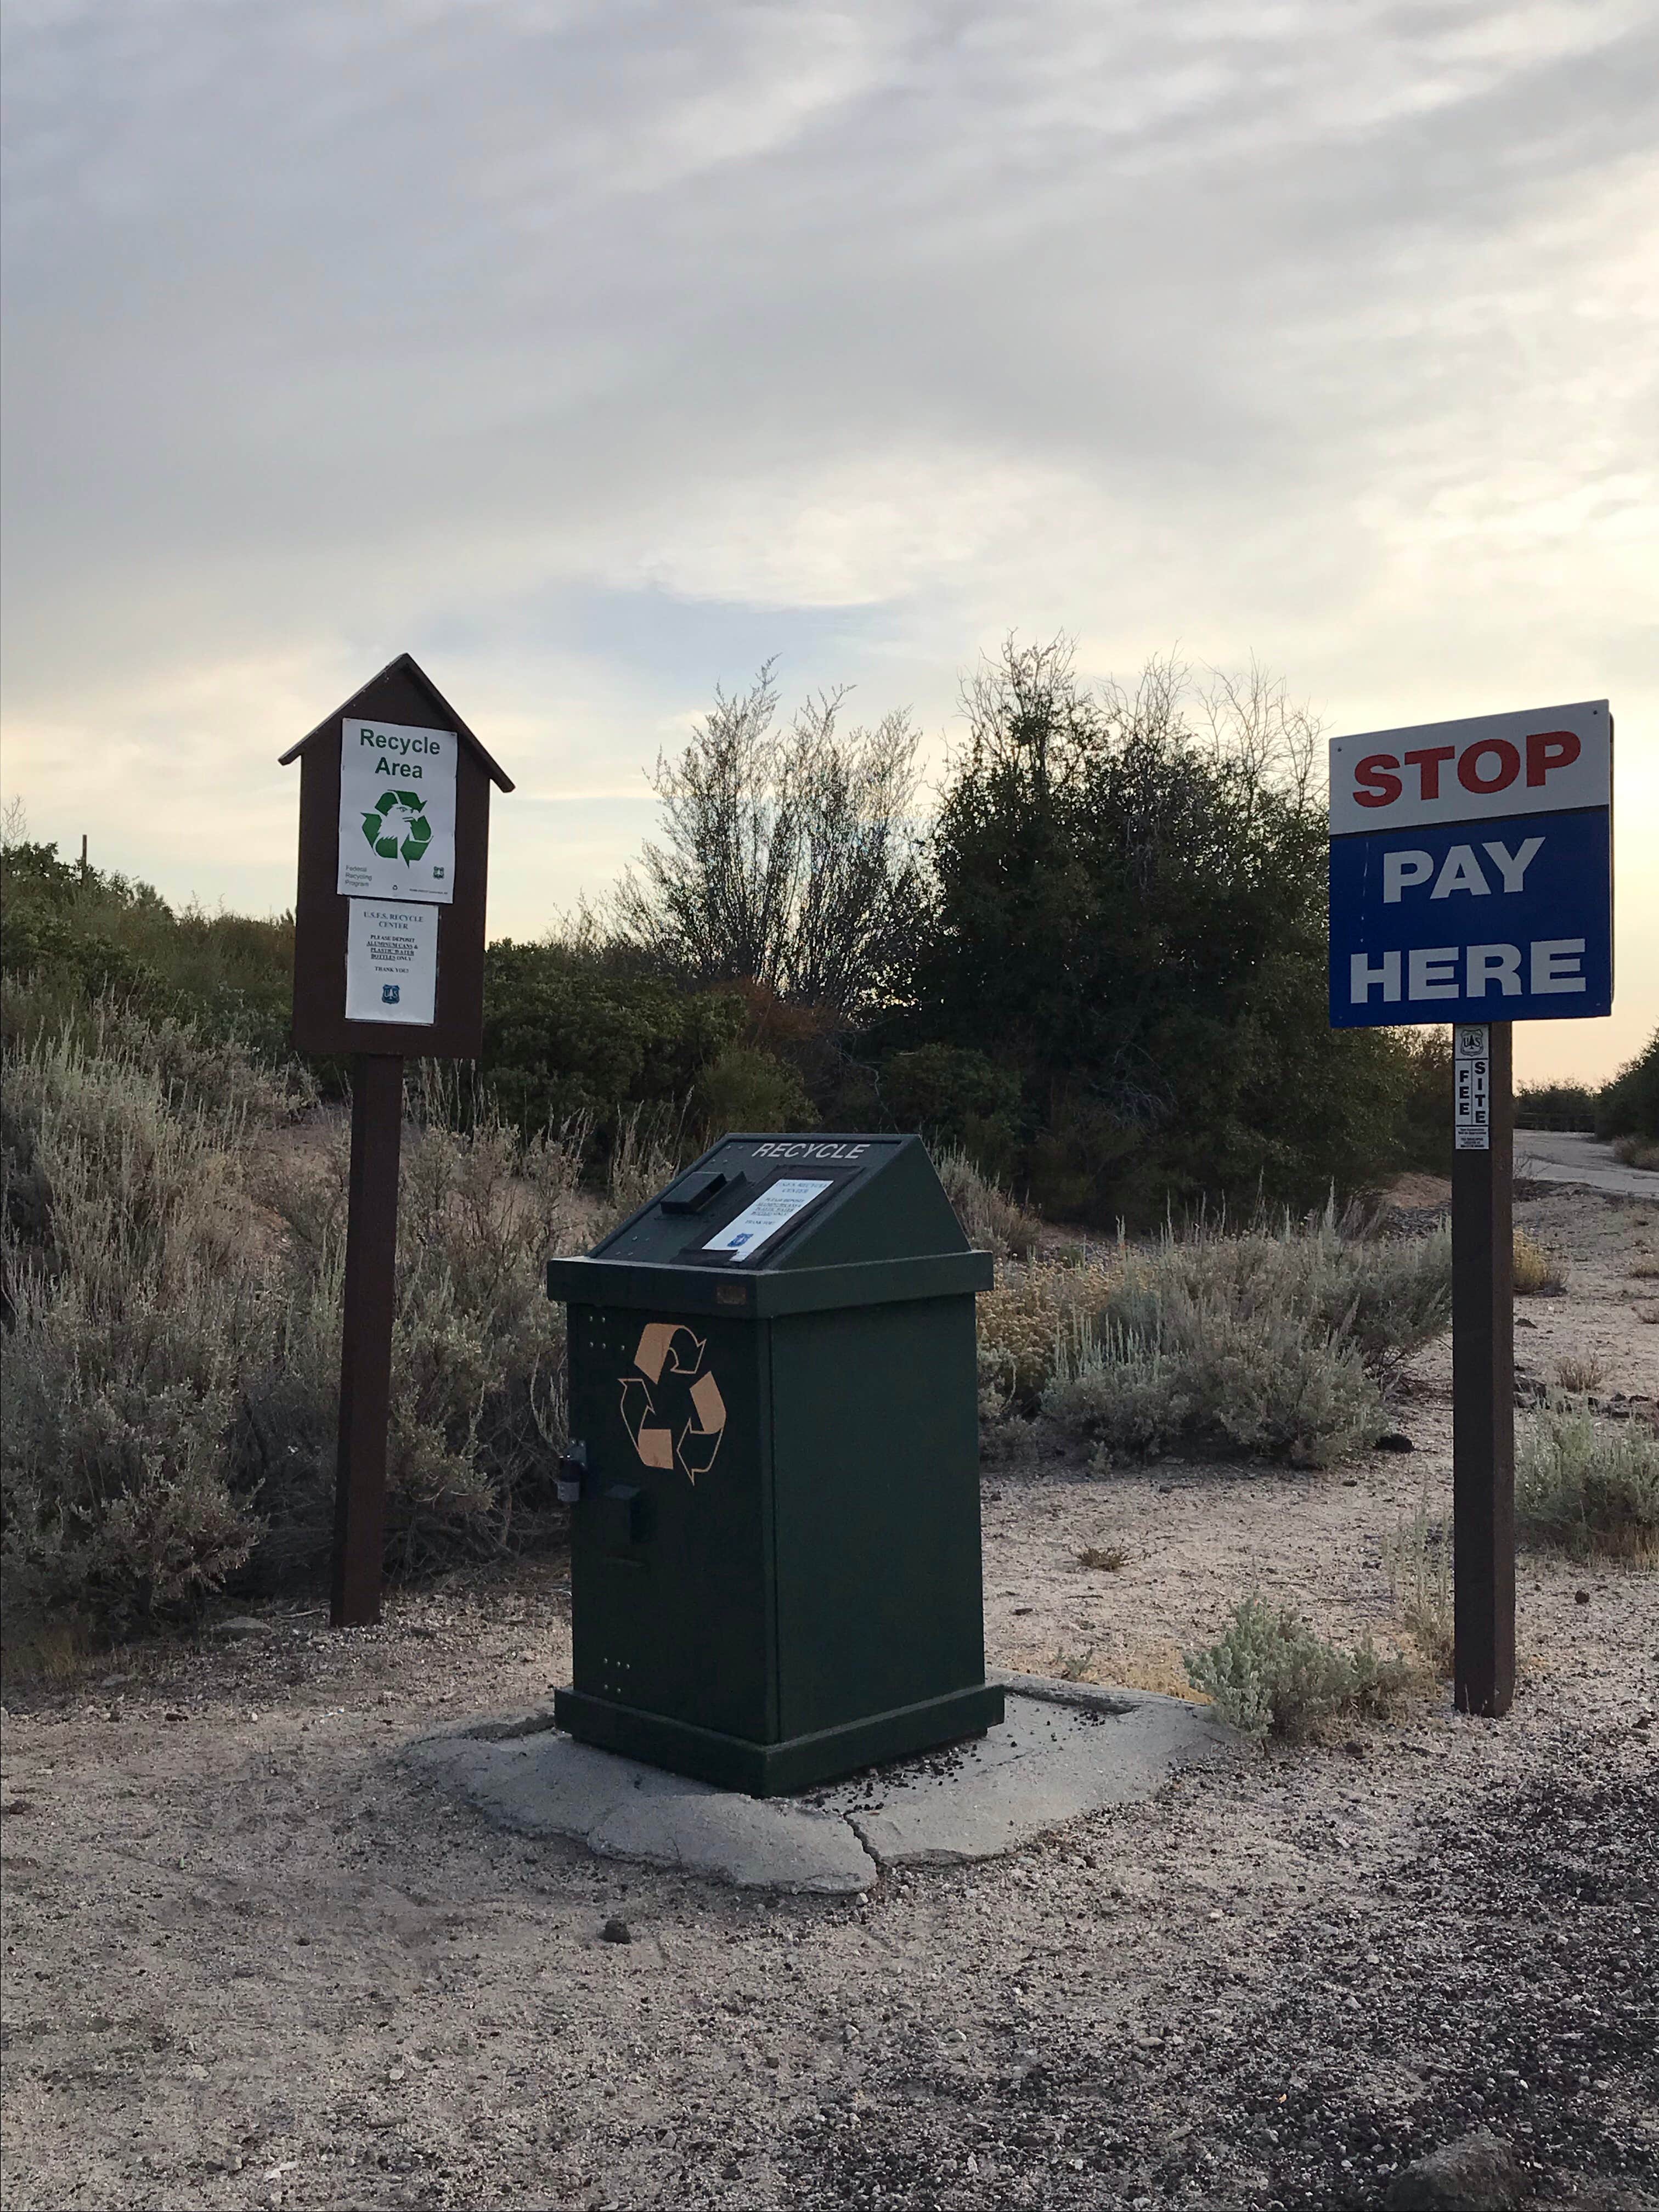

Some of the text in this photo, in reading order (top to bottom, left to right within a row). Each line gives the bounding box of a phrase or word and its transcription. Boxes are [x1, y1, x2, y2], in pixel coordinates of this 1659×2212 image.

[360, 728, 441, 755] Recycle
[375, 757, 423, 778] Area
[1352, 731, 1581, 808] STOP
[345, 872, 372, 881] Recycling
[1384, 837, 1545, 904] PAY
[379, 921, 408, 929] CENTER
[390, 913, 424, 922] RECYCLE
[1351, 938, 1586, 1004] HERE
[1459, 1070, 1470, 1115] FEE
[1474, 1061, 1486, 1124] SITE
[752, 1143, 871, 1159] RECYCLE
